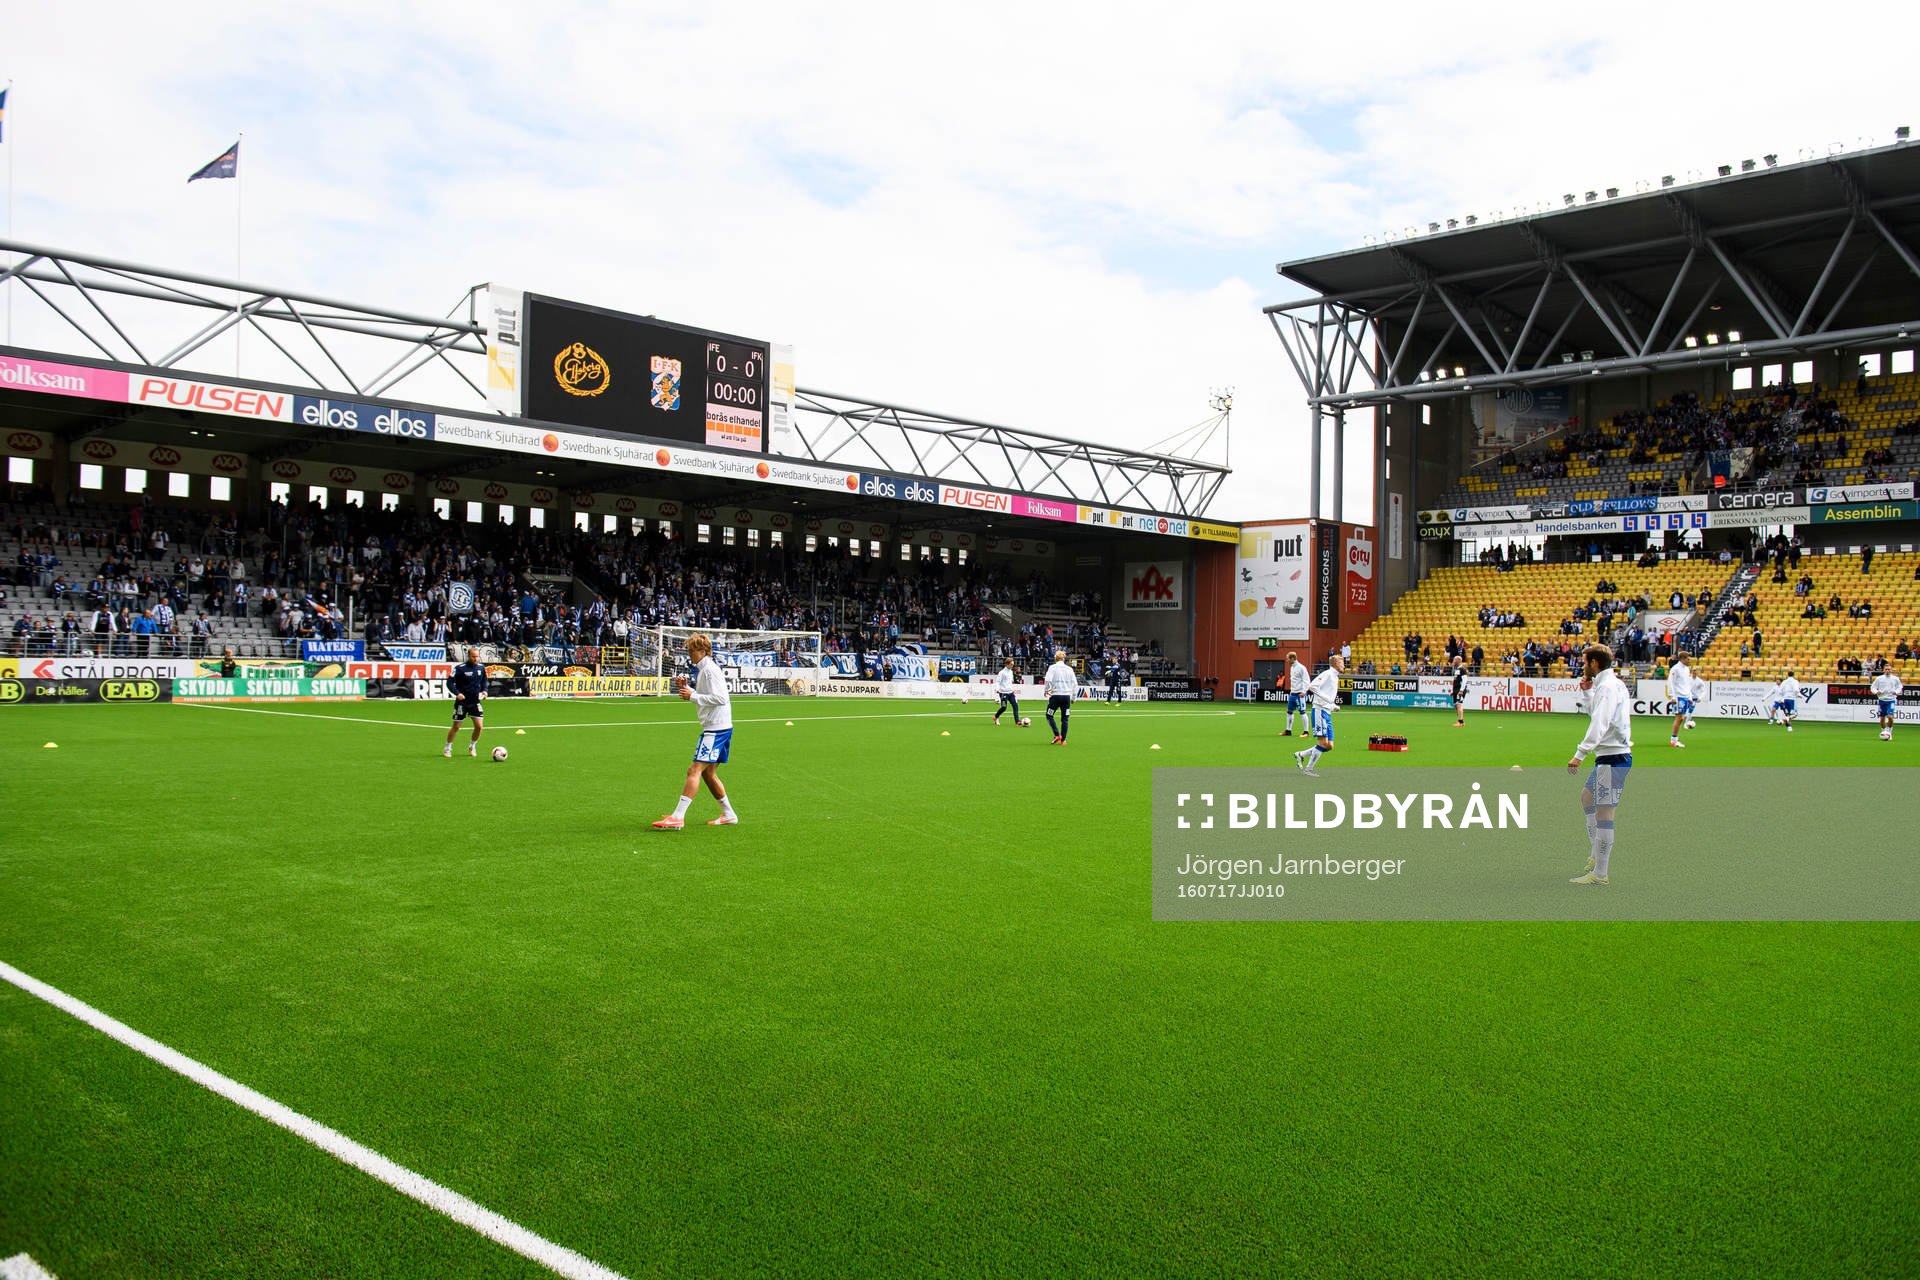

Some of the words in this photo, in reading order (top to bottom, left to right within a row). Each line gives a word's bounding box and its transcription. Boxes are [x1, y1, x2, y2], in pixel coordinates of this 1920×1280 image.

[716, 355, 726, 373] 0
[745, 361, 755, 378] 0
[139, 378, 285, 418] PULSEN
[714, 382, 756, 405] 00:00
[302, 399, 359, 430] ellos
[729, 415, 761, 428] elhandel
[374, 409, 427, 438] ellos
[10, 436, 40, 448] AXA
[437, 422, 493, 442] Swedbank
[495, 430, 540, 450] Sjuhärad
[85, 443, 115, 456] AXA
[152, 450, 178, 463] AXA
[562, 439, 612, 456] Swedbank
[614, 446, 654, 463] Sjuhärad
[215, 457, 240, 469] AXA
[274, 463, 298, 474] AXA
[673, 454, 717, 470] Swedbank
[719, 460, 754, 476] Sjuhärad
[331, 469, 355, 480] AXA
[385, 475, 408, 486] AXA
[771, 467, 811, 482] Swedbank
[813, 473, 845, 487] Sjuhärad
[437, 481, 458, 491] AXA
[486, 486, 506, 498] AXA
[864, 476, 896, 497] ellos
[905, 481, 934, 503] ellos
[943, 488, 1008, 511] PULSEN
[659, 505, 677, 514] AXA
[1028, 501, 1062, 517] Folksam
[1825, 505, 1902, 521] Assemblin
[1420, 526, 1451, 538] onyx
[1535, 520, 1617, 533] Handelsbanken
[1349, 545, 1371, 566] City
[1131, 563, 1175, 601] MAX
[308, 641, 356, 652] HATERS
[521, 664, 559, 676] tunna
[106, 683, 154, 699] EAB
[179, 680, 235, 696] SKYDDA
[247, 680, 300, 696] SKYDDA
[311, 679, 361, 695] SKYDDA
[840, 685, 880, 694] DJURPARK
[1481, 696, 1551, 712] PLANTAGEN
[1720, 704, 1760, 716] STIBA
